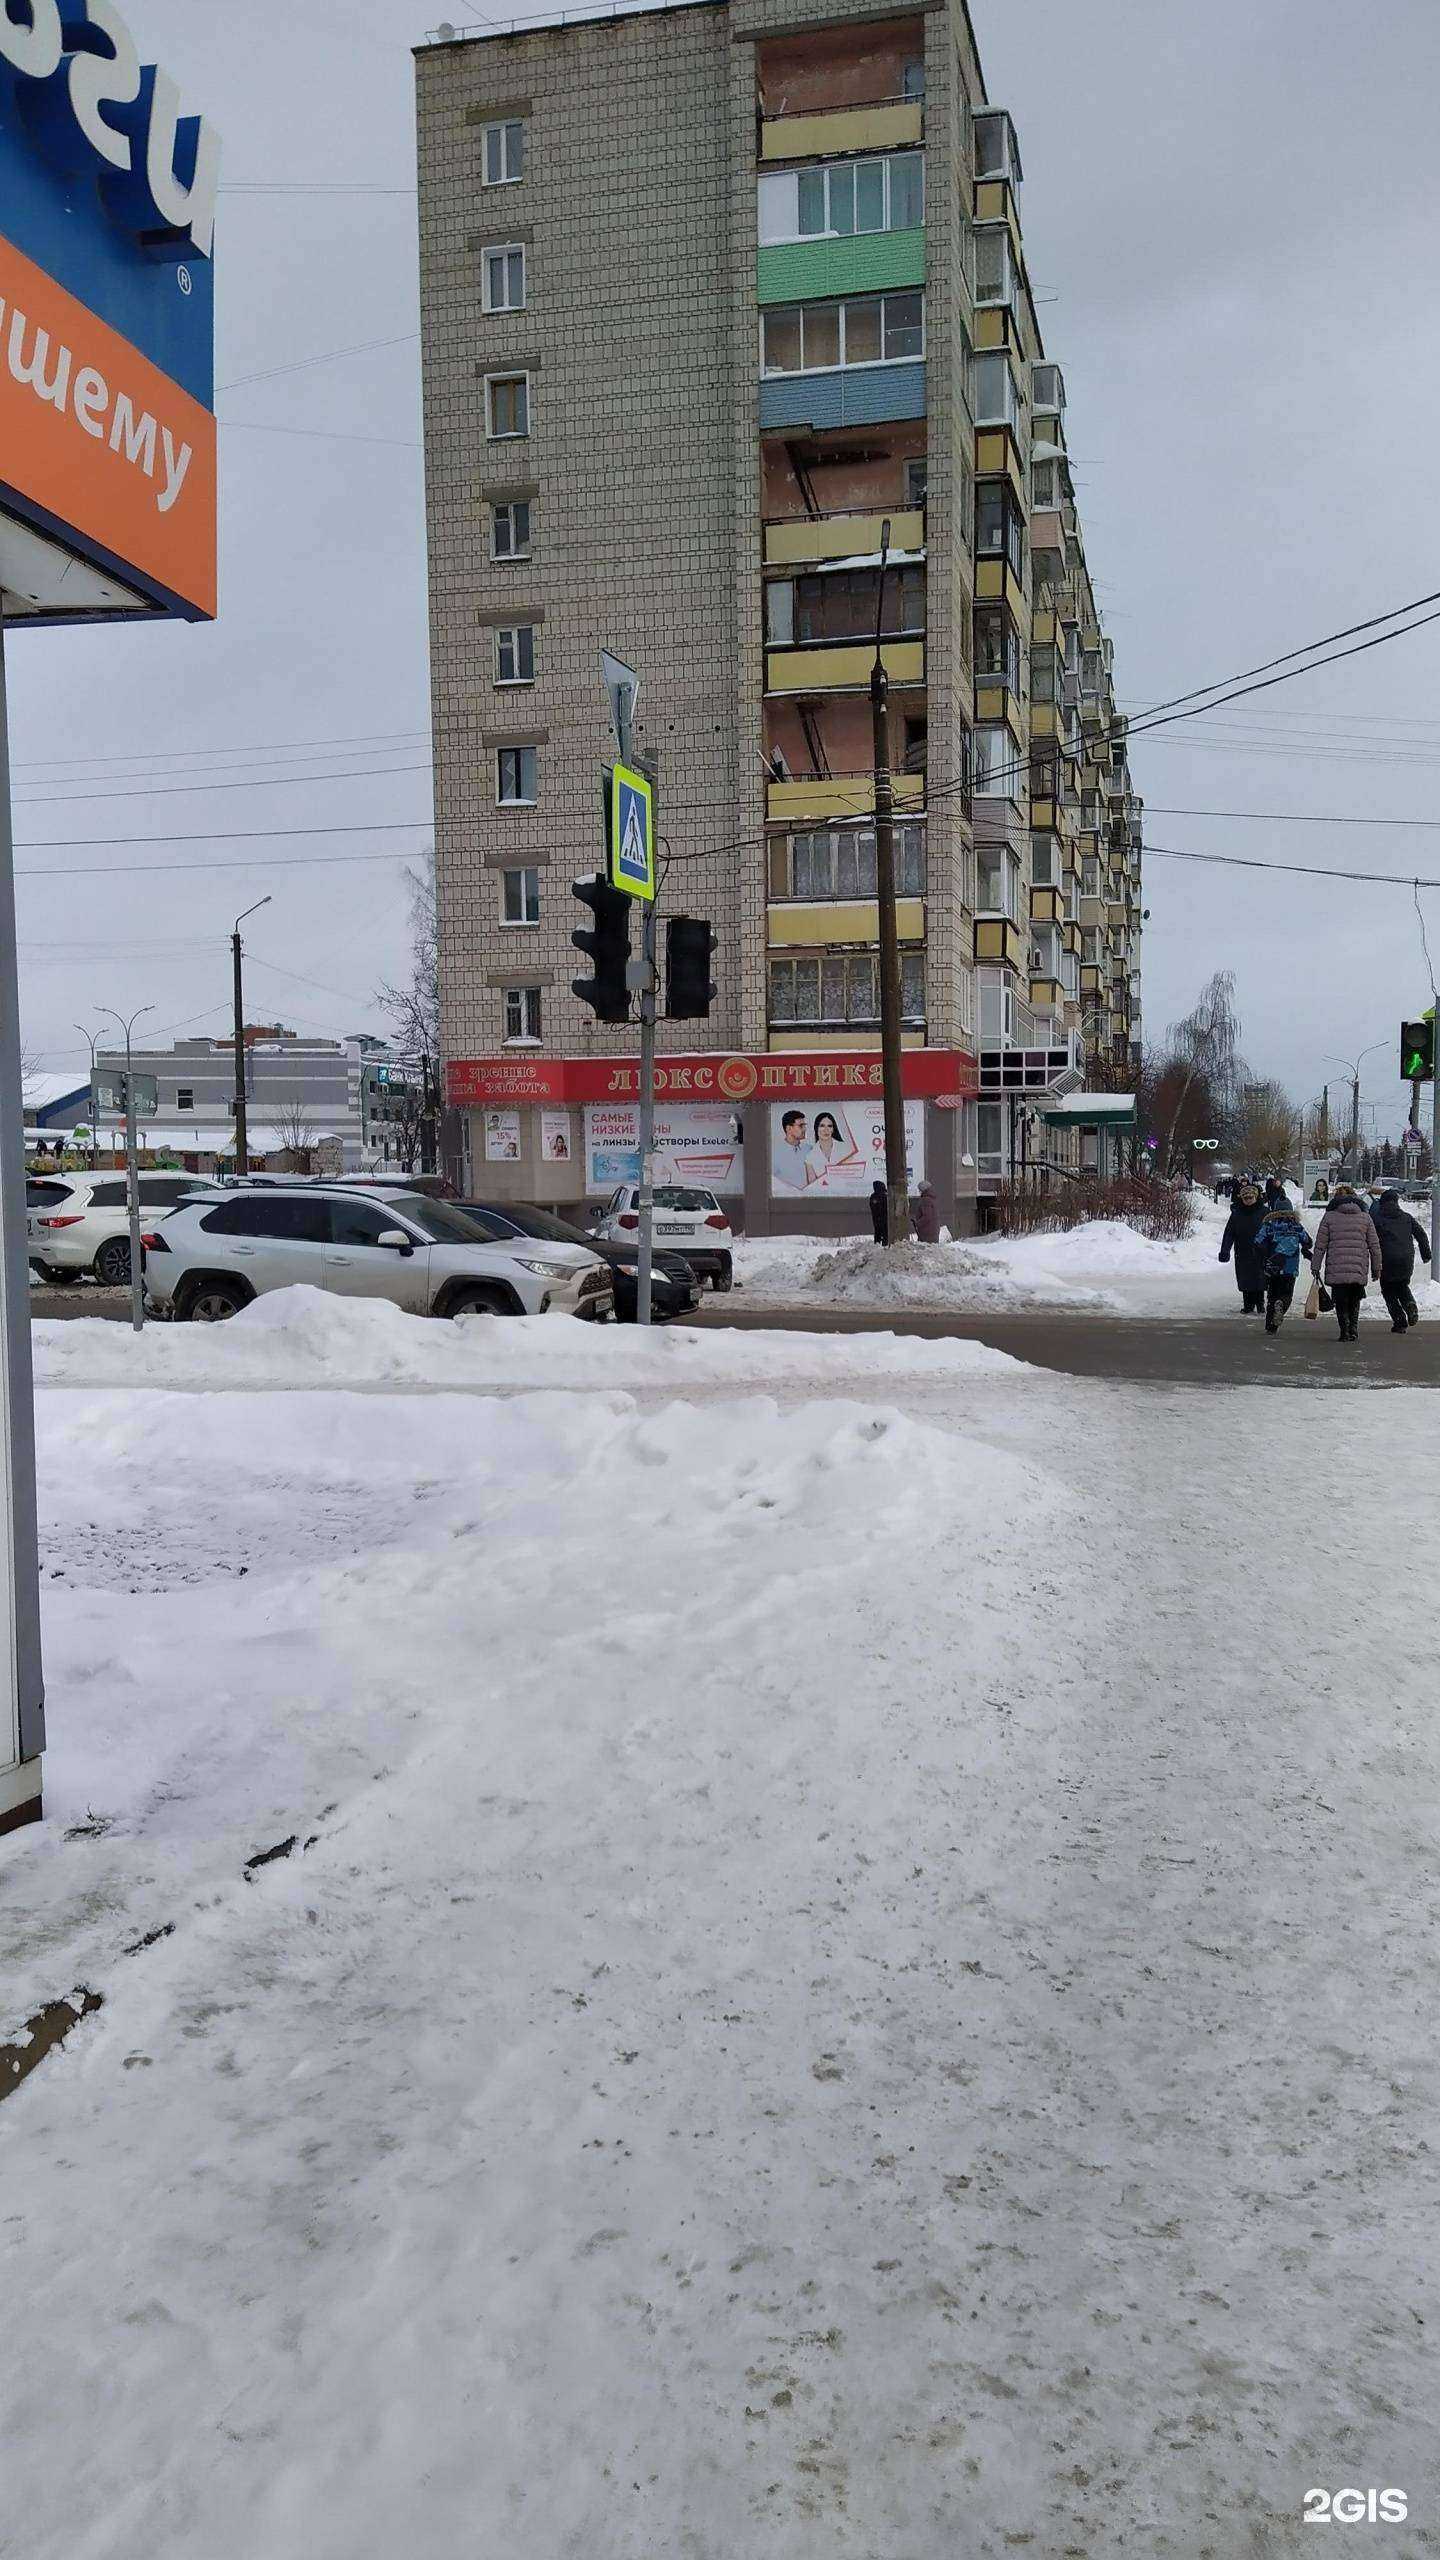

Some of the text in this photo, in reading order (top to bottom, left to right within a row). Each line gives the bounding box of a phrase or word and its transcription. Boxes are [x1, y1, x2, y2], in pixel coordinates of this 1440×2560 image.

[0, 297, 192, 512] шему
[591, 1113, 634, 1123] САМЫЕ
[592, 1124, 671, 1135] НИЗКИЕ НЫ
[496, 1131, 512, 1140] 15%
[602, 1139, 636, 1147] линзы
[651, 1137, 700, 1148] створы
